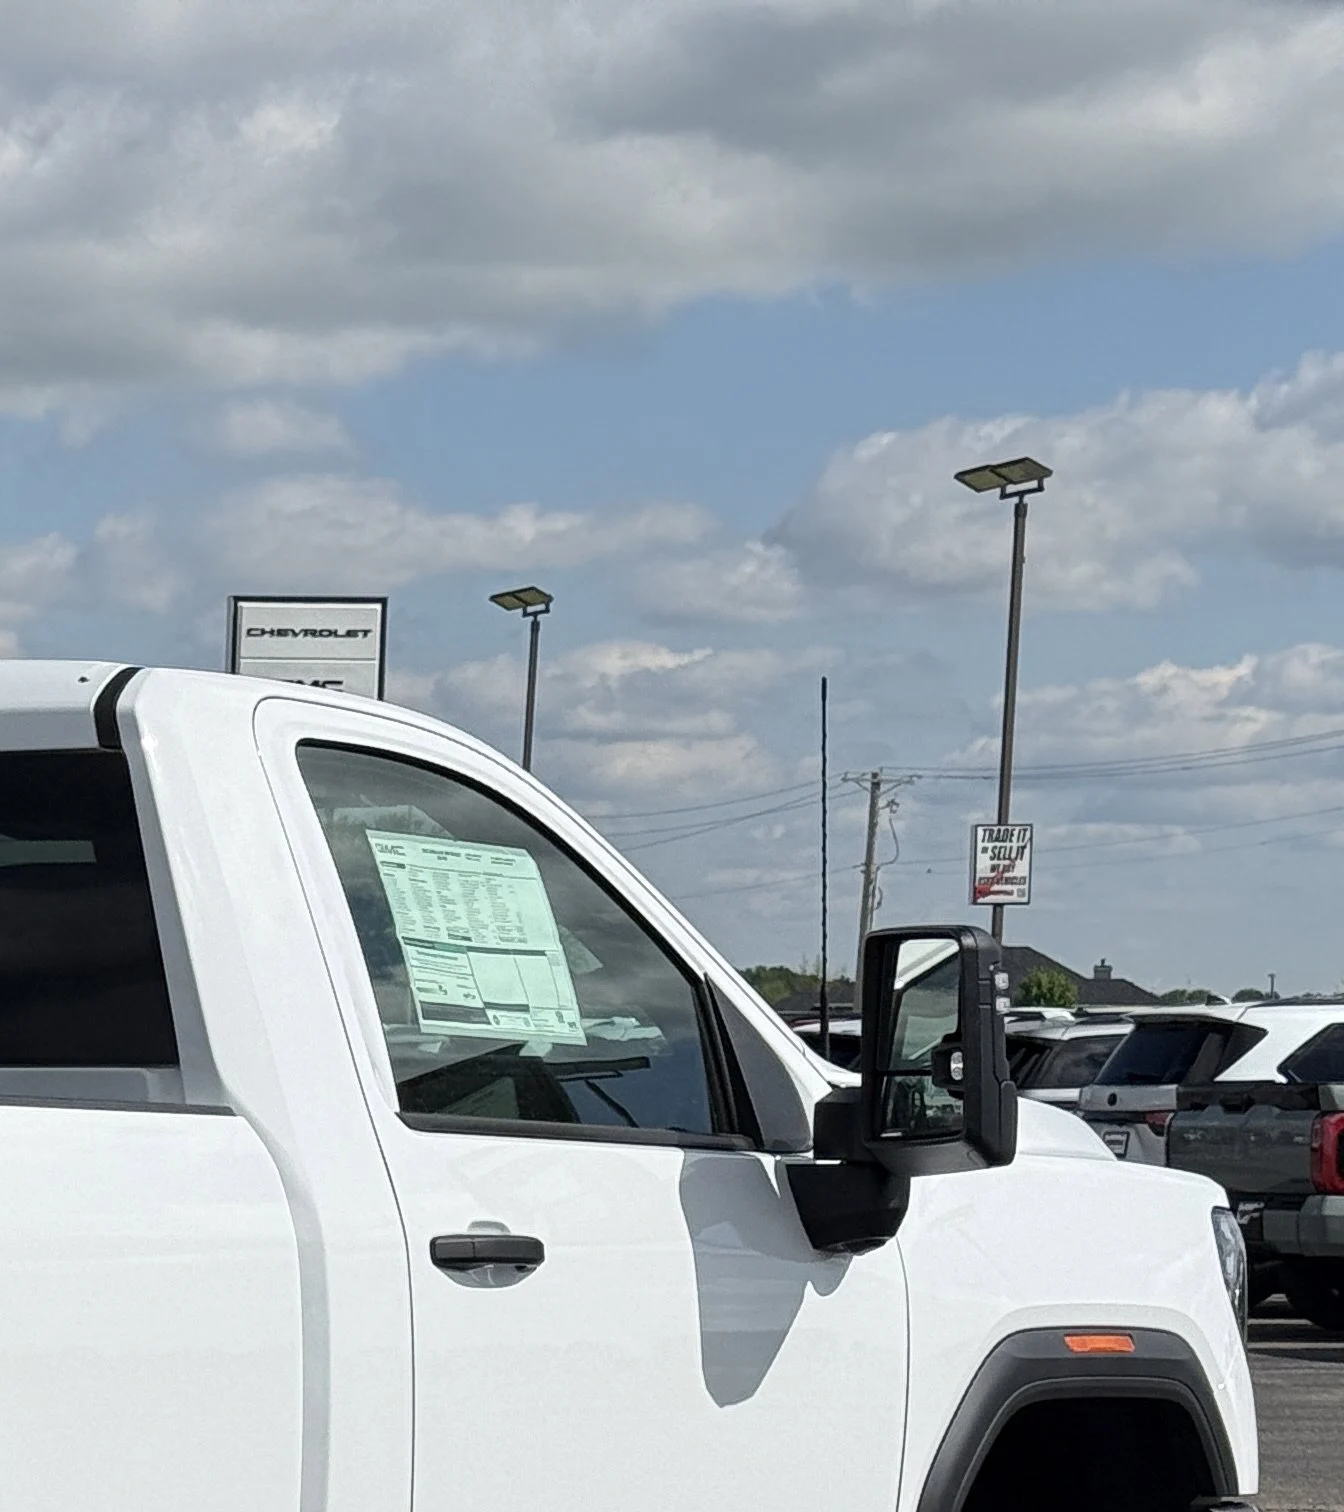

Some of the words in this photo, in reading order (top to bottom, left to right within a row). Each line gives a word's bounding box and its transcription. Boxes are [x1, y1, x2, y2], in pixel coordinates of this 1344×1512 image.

[246, 627, 373, 639] CHEVROLET
[981, 828, 1015, 843] TRADE
[1016, 828, 1029, 843] IT
[989, 845, 1013, 861] SELL
